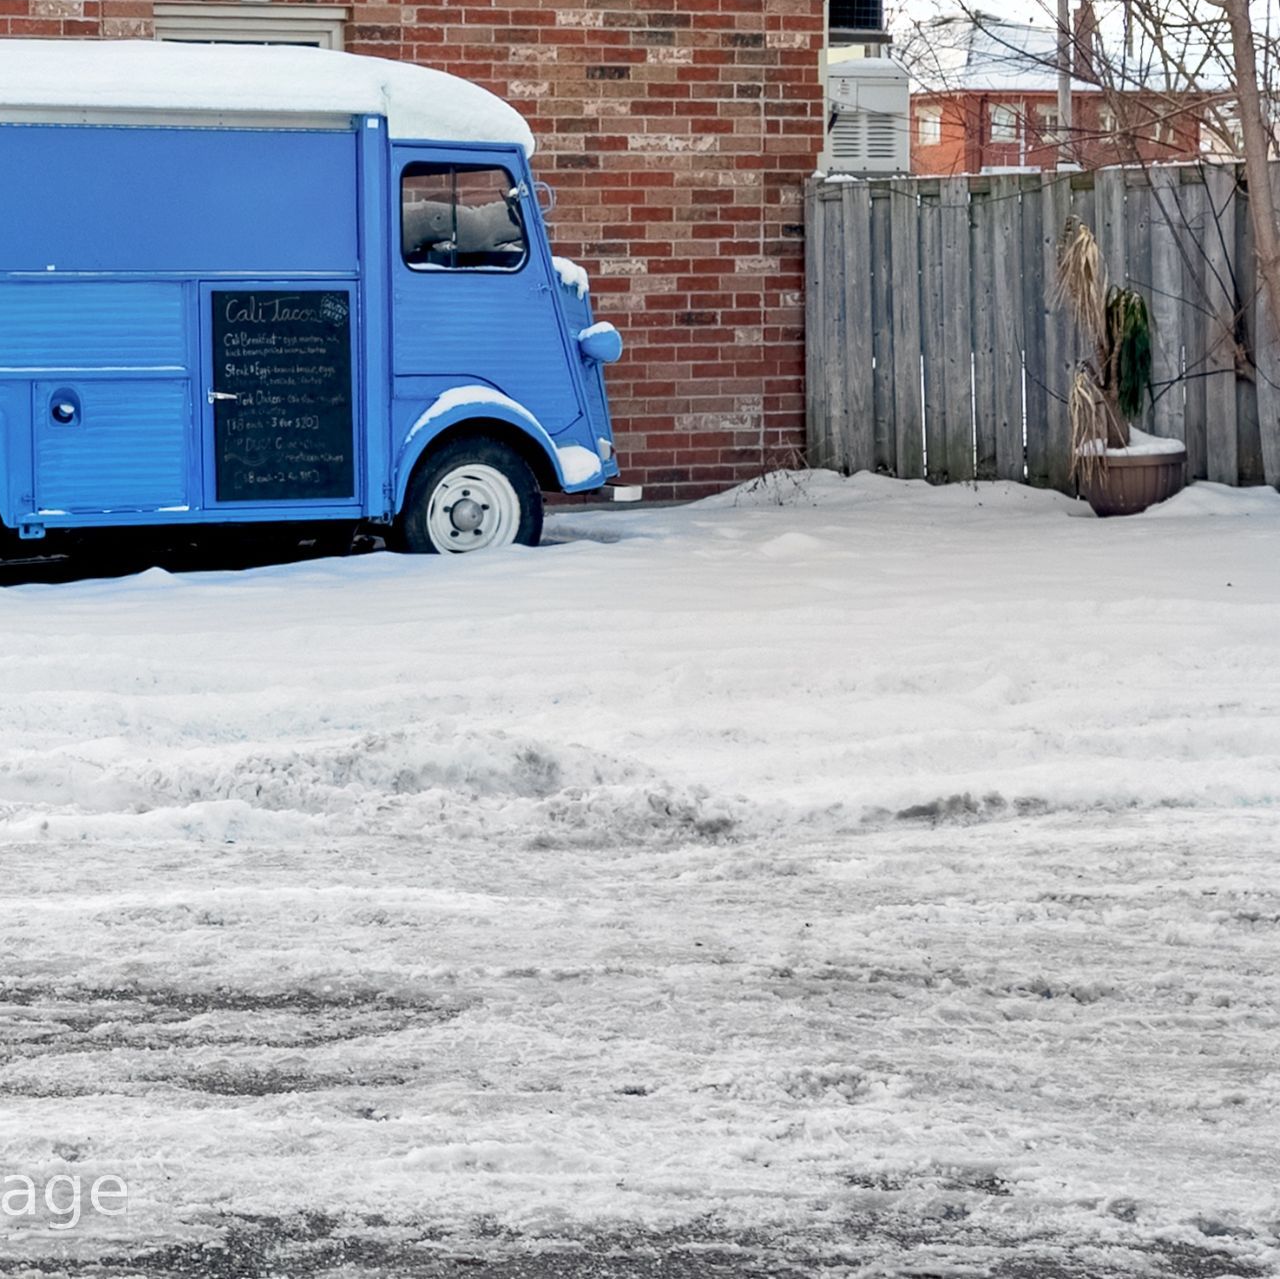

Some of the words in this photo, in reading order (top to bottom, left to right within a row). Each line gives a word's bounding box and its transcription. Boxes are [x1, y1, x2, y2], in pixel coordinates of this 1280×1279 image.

[226, 296, 266, 323] Cali
[263, 295, 323, 323] Tacos
[224, 363, 249, 377] Steak
